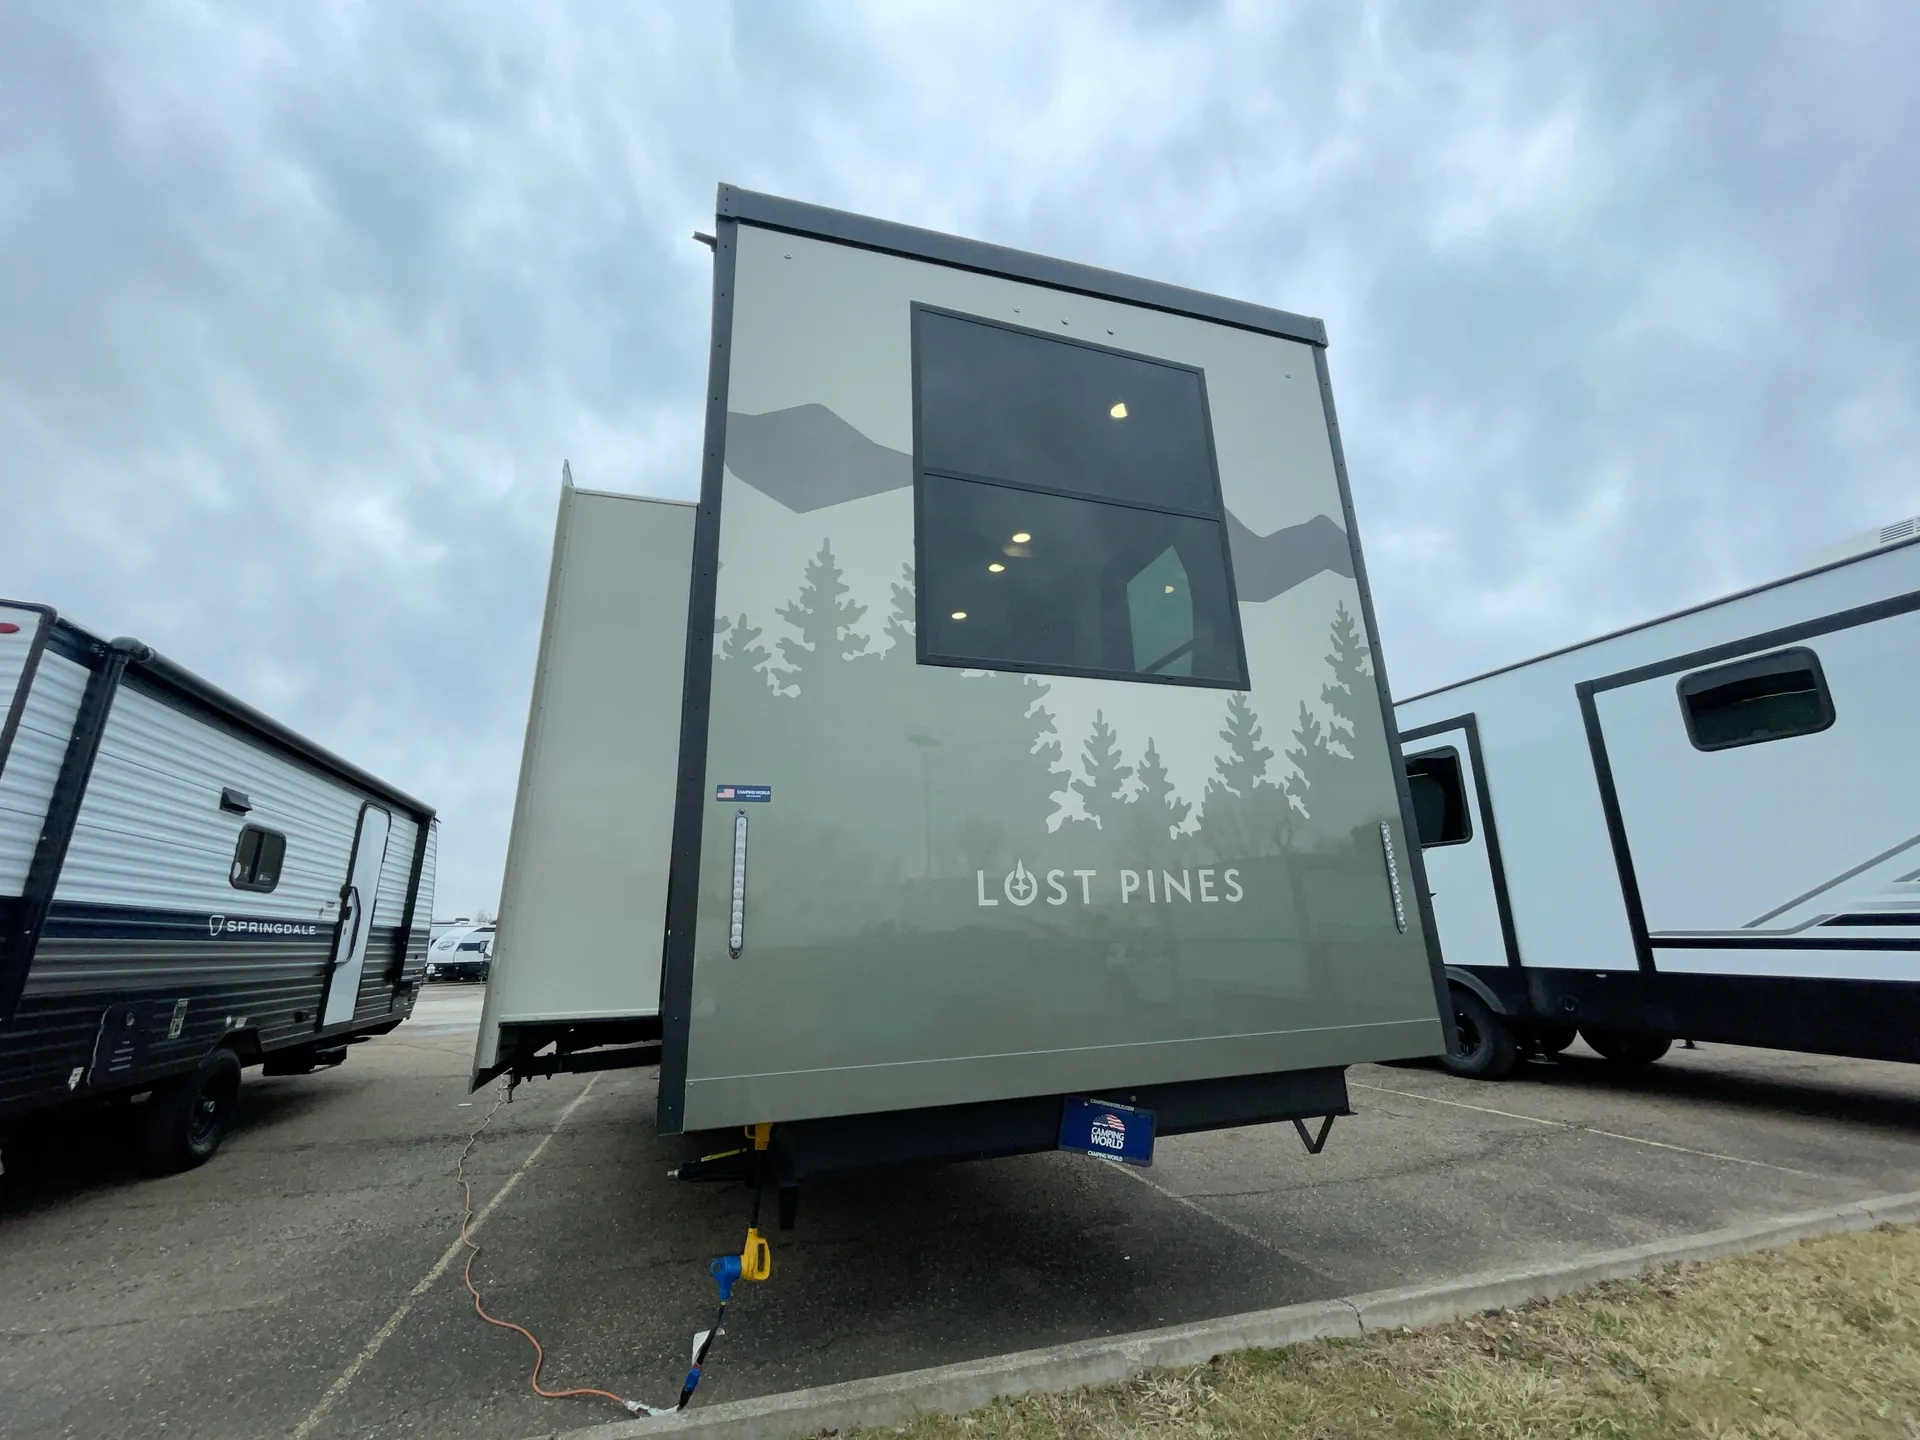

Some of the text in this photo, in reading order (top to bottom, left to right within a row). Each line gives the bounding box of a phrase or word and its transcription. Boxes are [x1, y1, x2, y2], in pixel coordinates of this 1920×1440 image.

[977, 859, 1244, 907] LOST PINES
[226, 920, 317, 936] SPRINGDALE
[1091, 1126, 1125, 1141] CAMPING
[1090, 1134, 1124, 1150] WORLD
[1087, 1150, 1123, 1162] CAMPING WORLD
